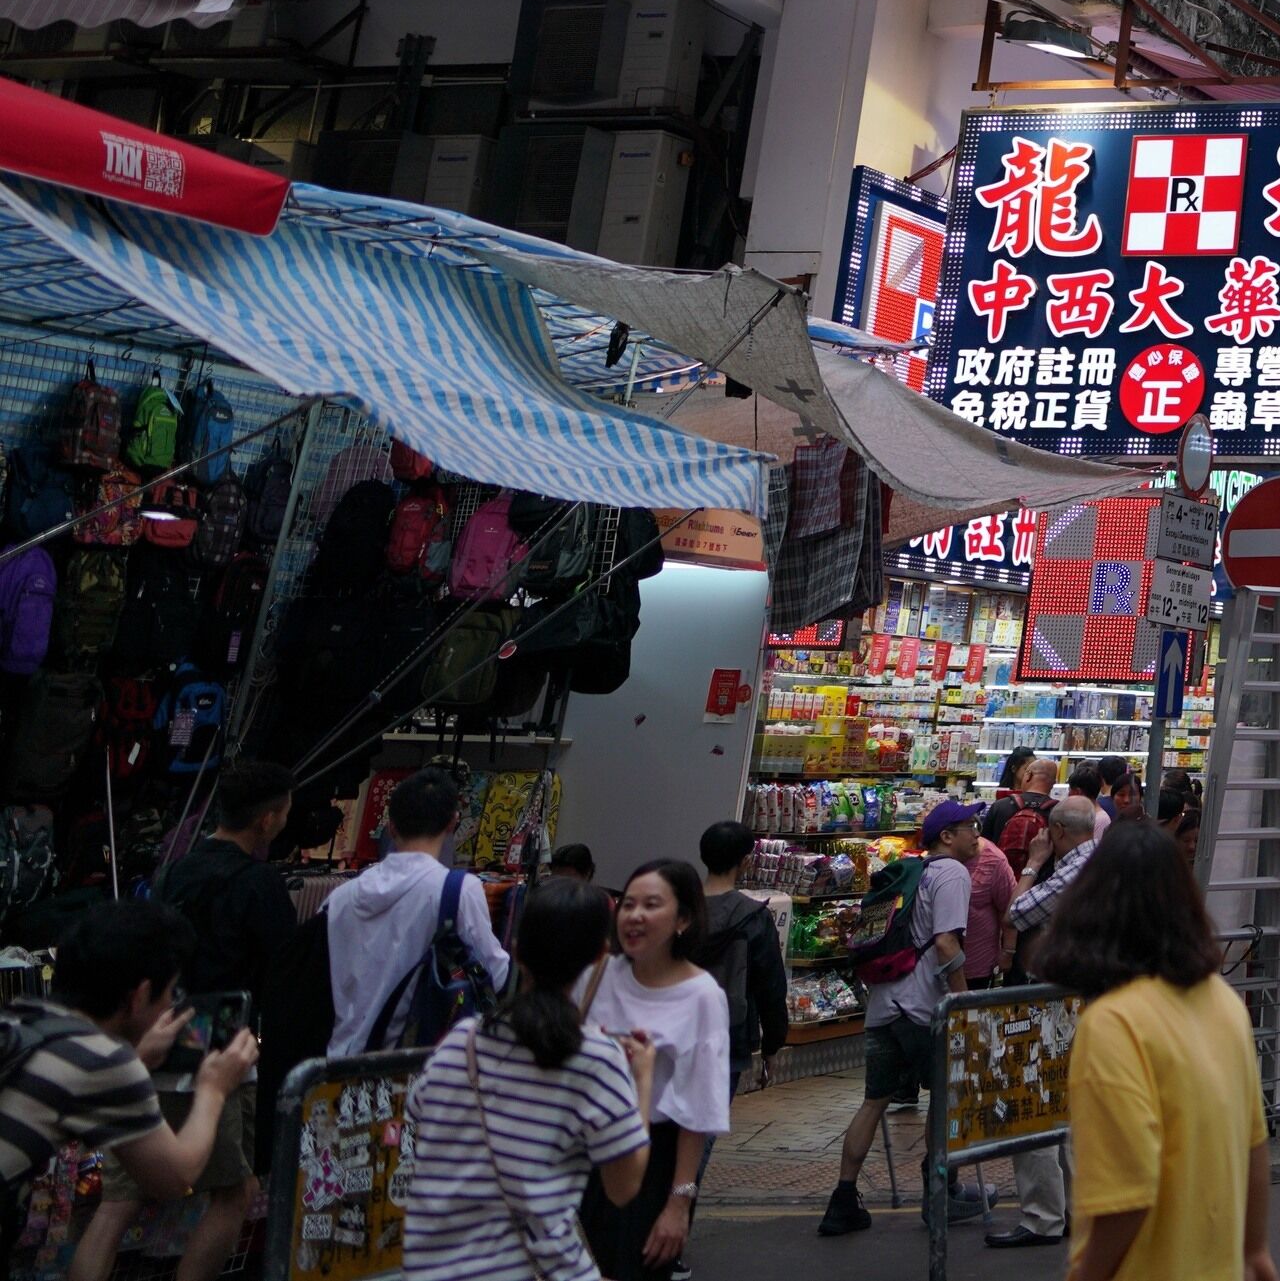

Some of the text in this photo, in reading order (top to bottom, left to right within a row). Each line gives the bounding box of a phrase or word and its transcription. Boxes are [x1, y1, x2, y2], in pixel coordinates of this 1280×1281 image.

[975, 135, 1103, 258] 龍
[954, 346, 1118, 388] 政府註冊
[1136, 380, 1183, 425] 正
[1204, 512, 1214, 531] 12
[1198, 603, 1208, 624] 12
[1004, 1019, 1032, 1036] PLEASURES
